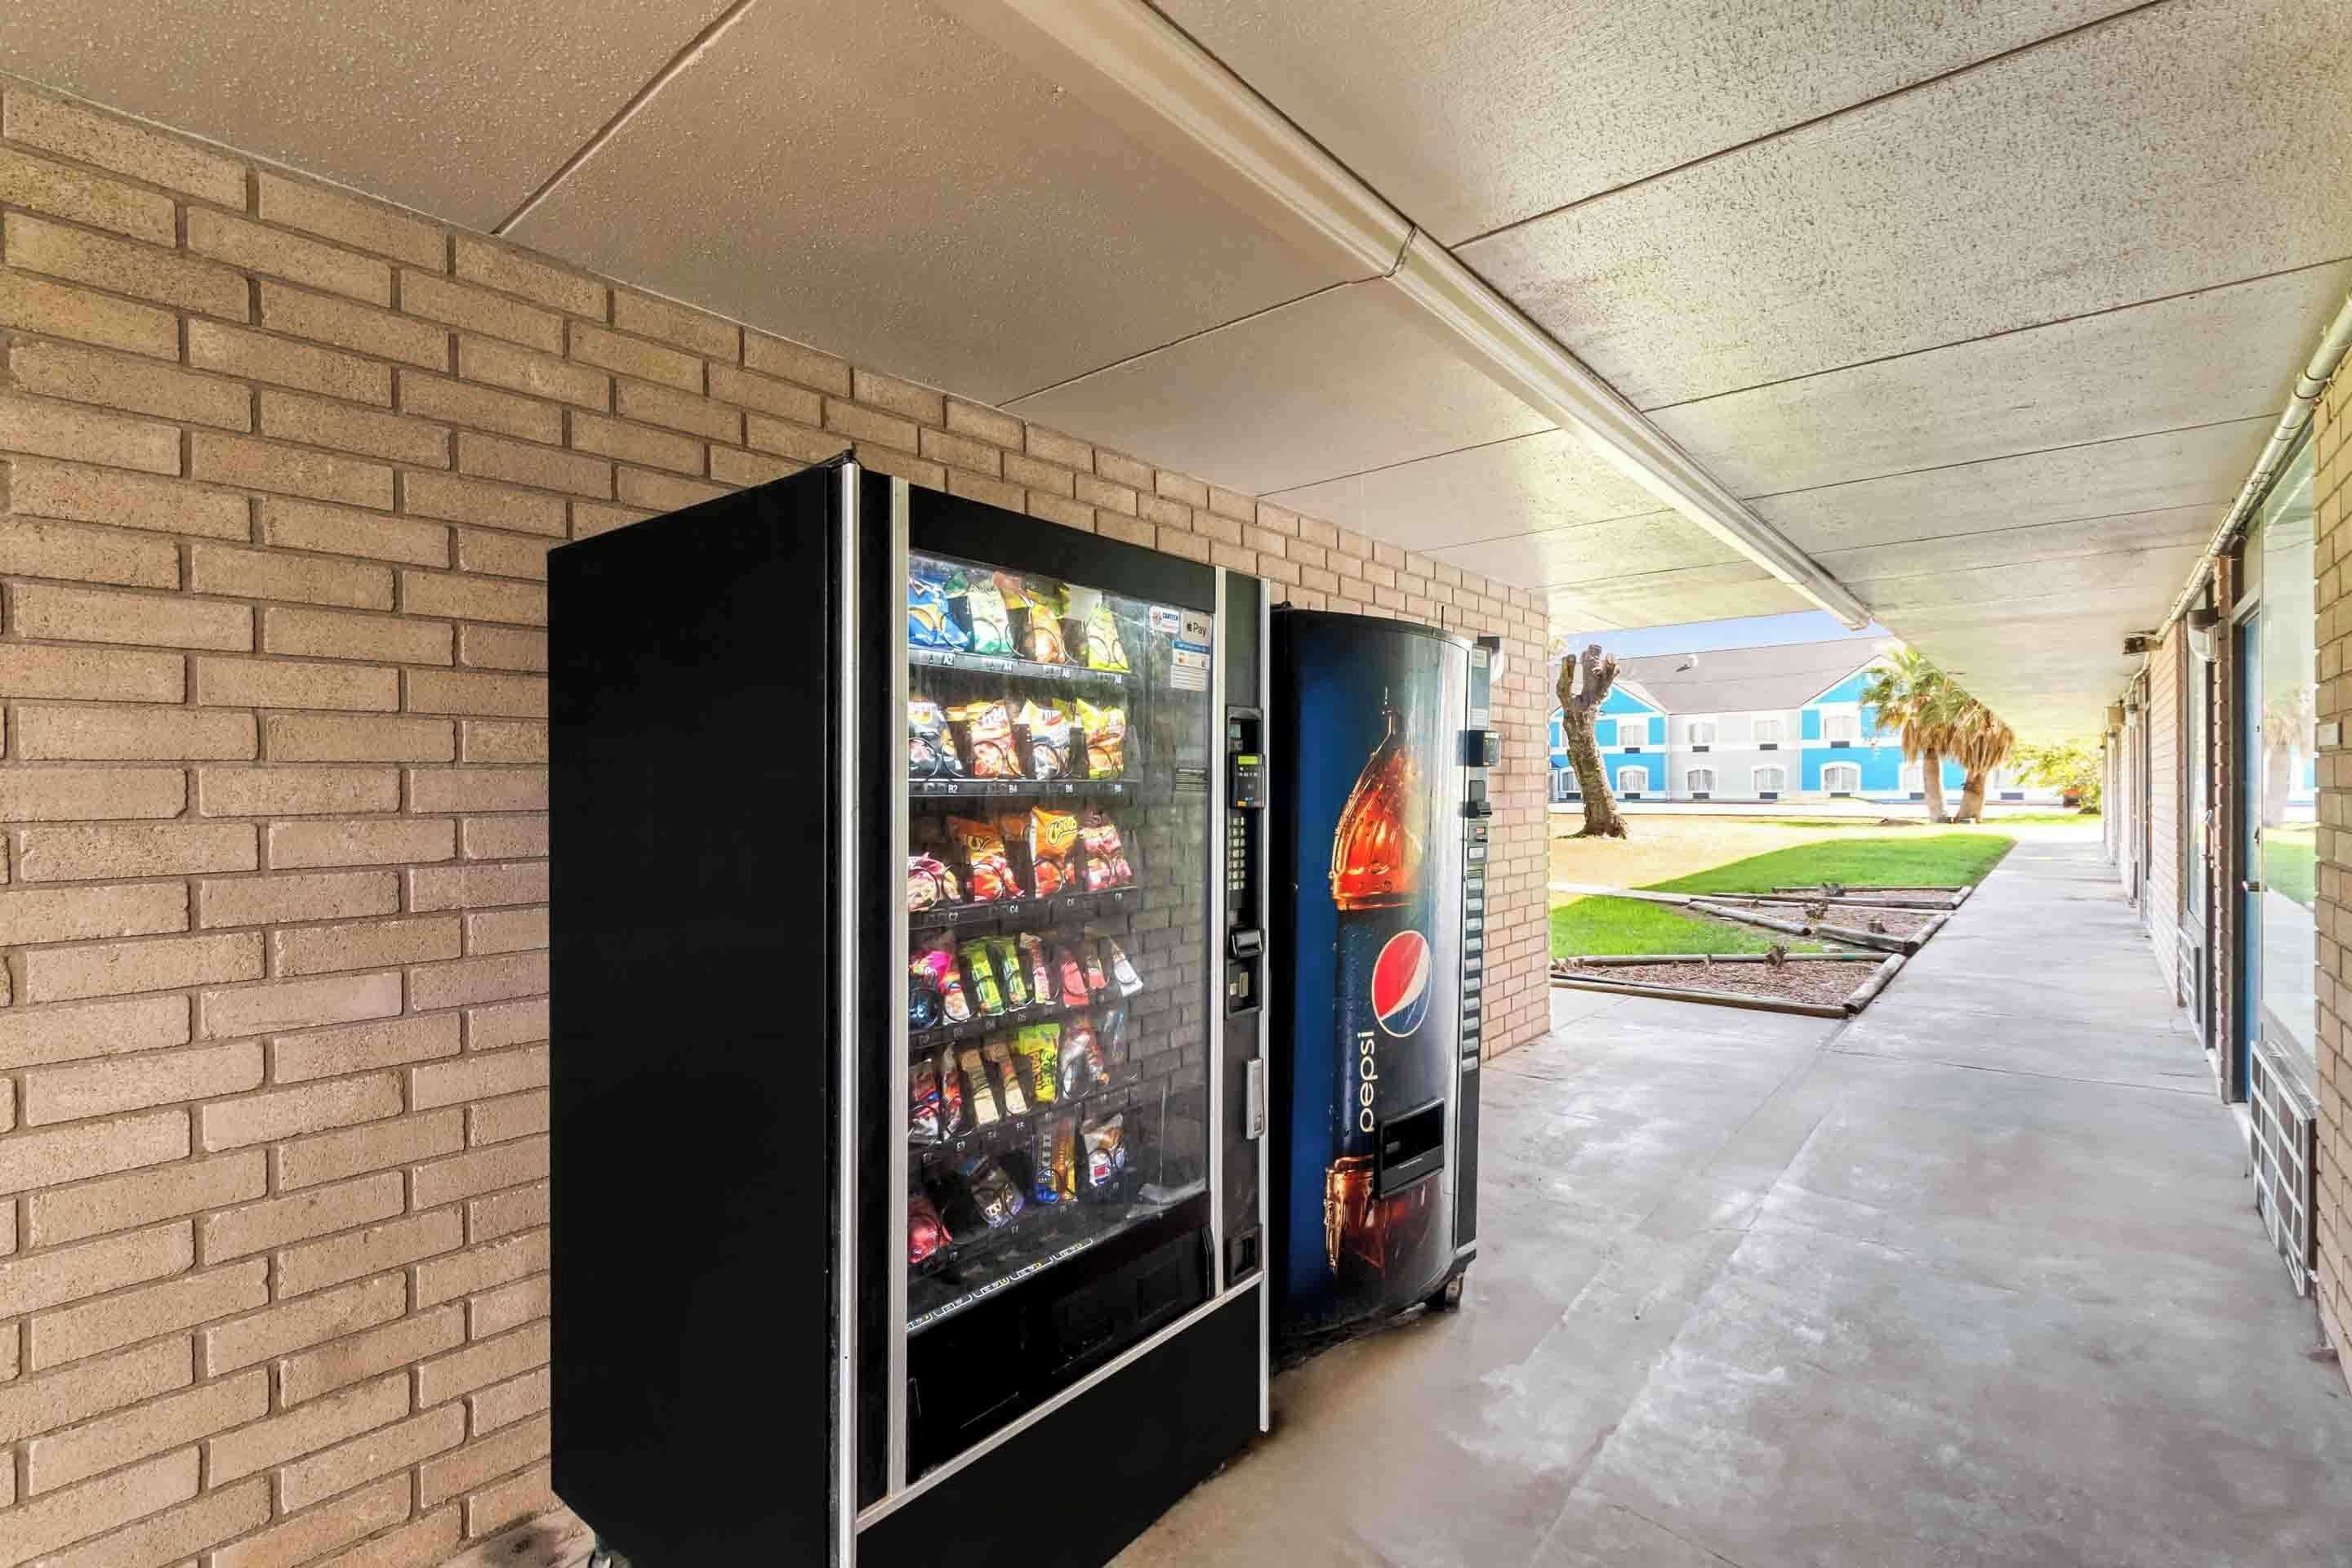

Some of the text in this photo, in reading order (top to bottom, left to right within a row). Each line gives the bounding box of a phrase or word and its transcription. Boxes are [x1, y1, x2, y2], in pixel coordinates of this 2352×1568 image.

[1192, 622, 1207, 637] Pay
[948, 784, 957, 793] B2
[1009, 784, 1018, 793] B4
[1357, 1031, 1379, 1132] pepsi
